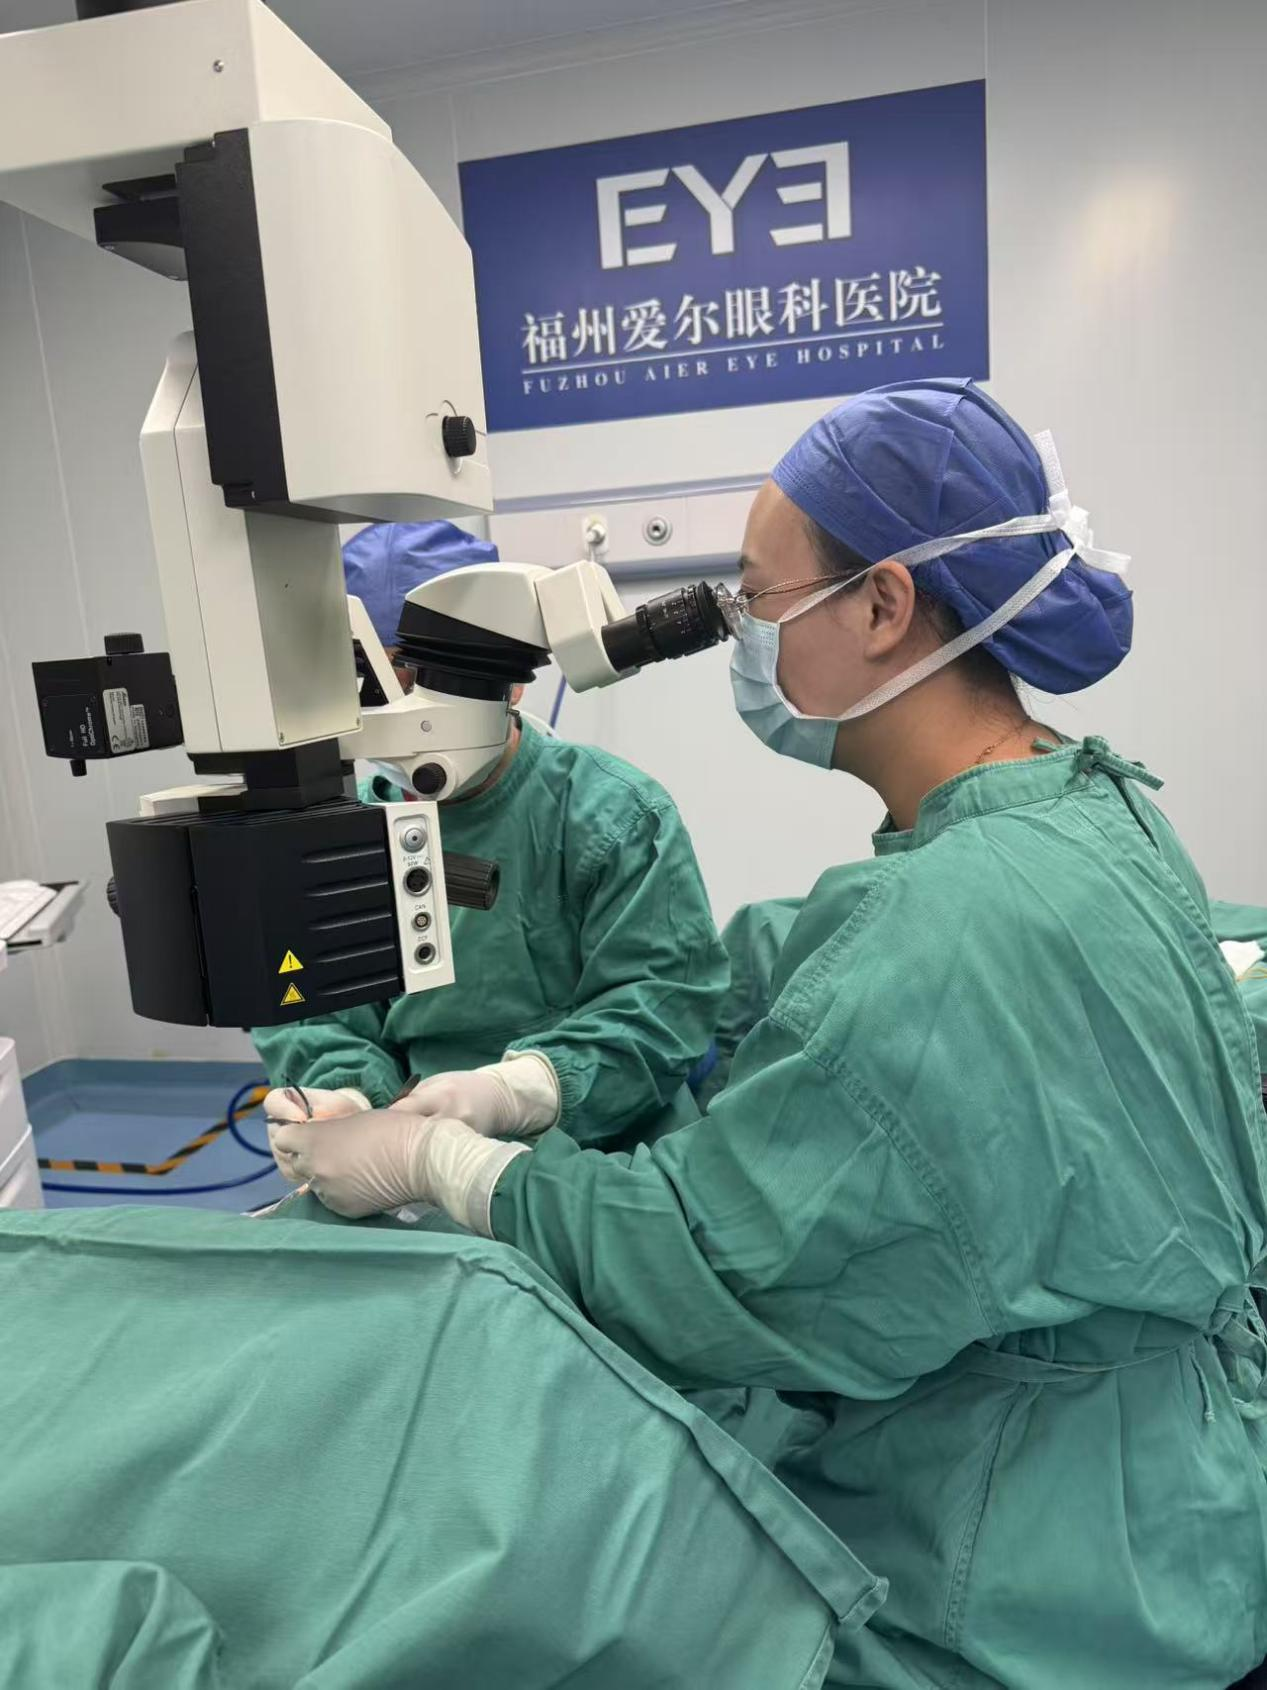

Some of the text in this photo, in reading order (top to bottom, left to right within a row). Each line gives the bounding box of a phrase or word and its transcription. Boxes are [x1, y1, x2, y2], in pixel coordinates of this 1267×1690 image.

[521, 266, 941, 364] 福州爱尔眼科医院
[523, 335, 944, 395] FUZHOU AIER EYE HOSPITAL
